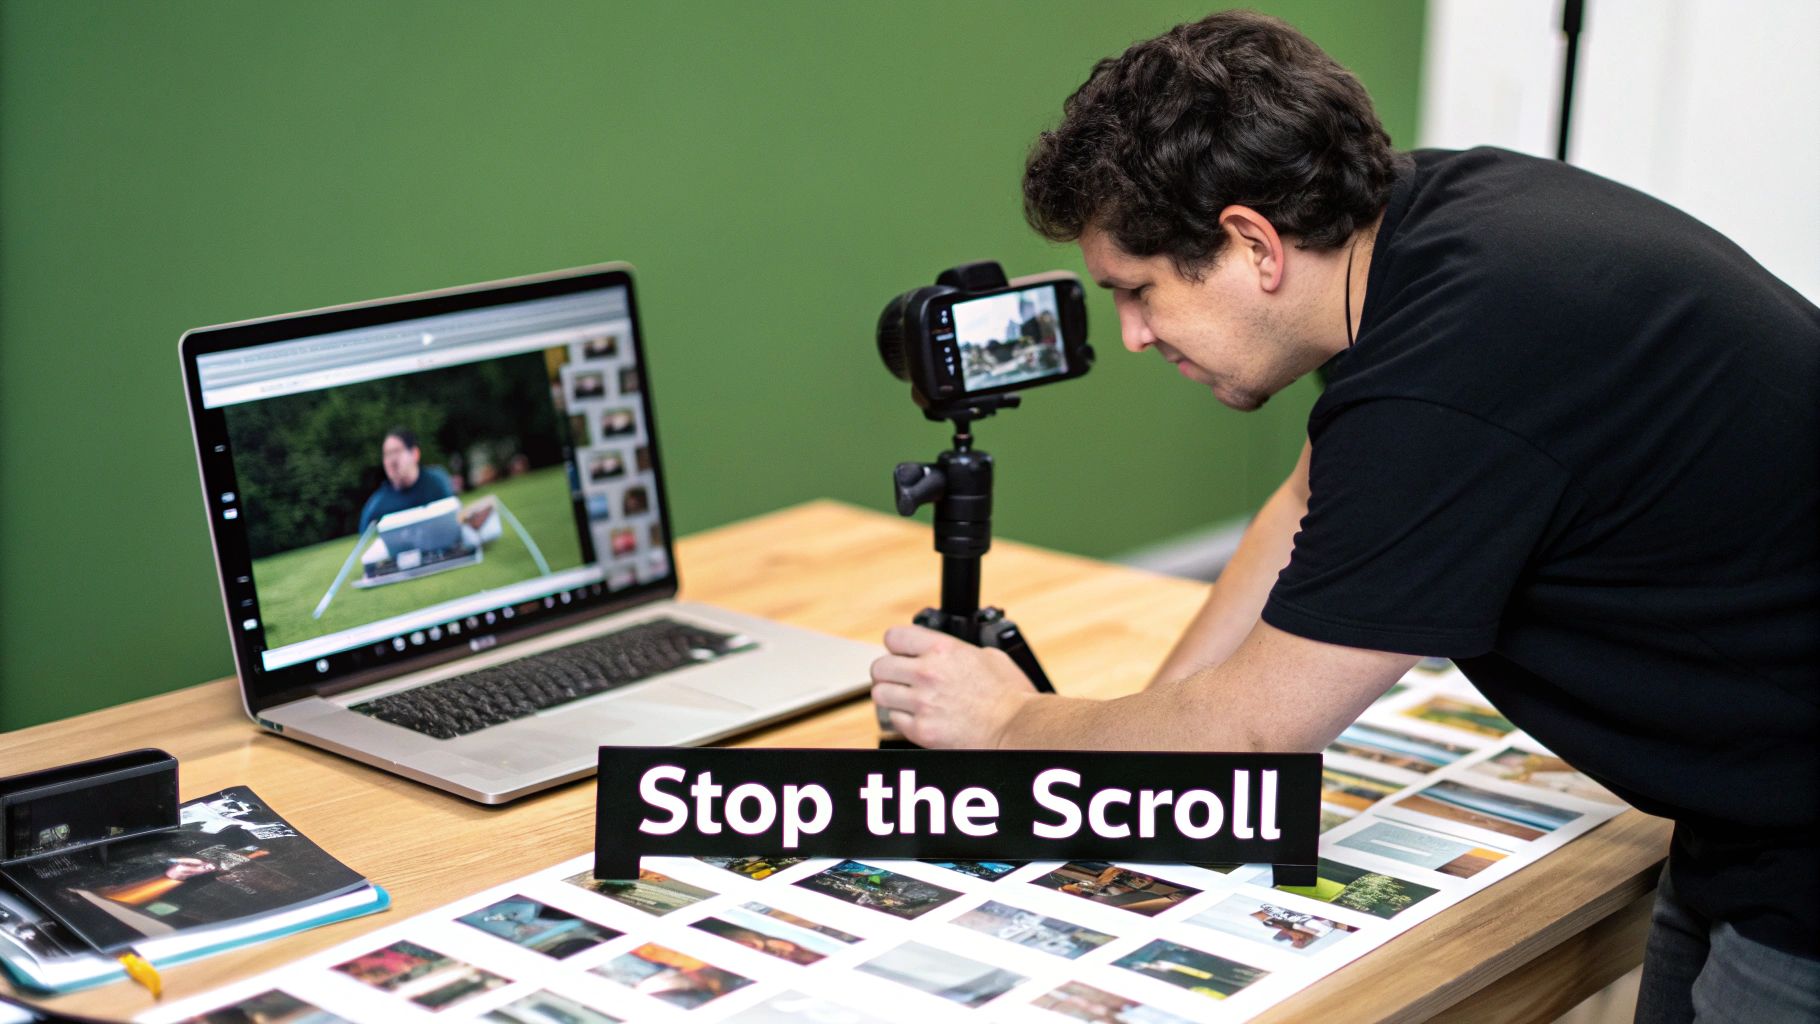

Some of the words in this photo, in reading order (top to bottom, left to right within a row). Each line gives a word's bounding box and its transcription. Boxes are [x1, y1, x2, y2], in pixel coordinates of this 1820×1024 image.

[639, 765, 833, 848] Stop
[860, 769, 999, 837] the
[1032, 768, 1281, 840] Scroll
